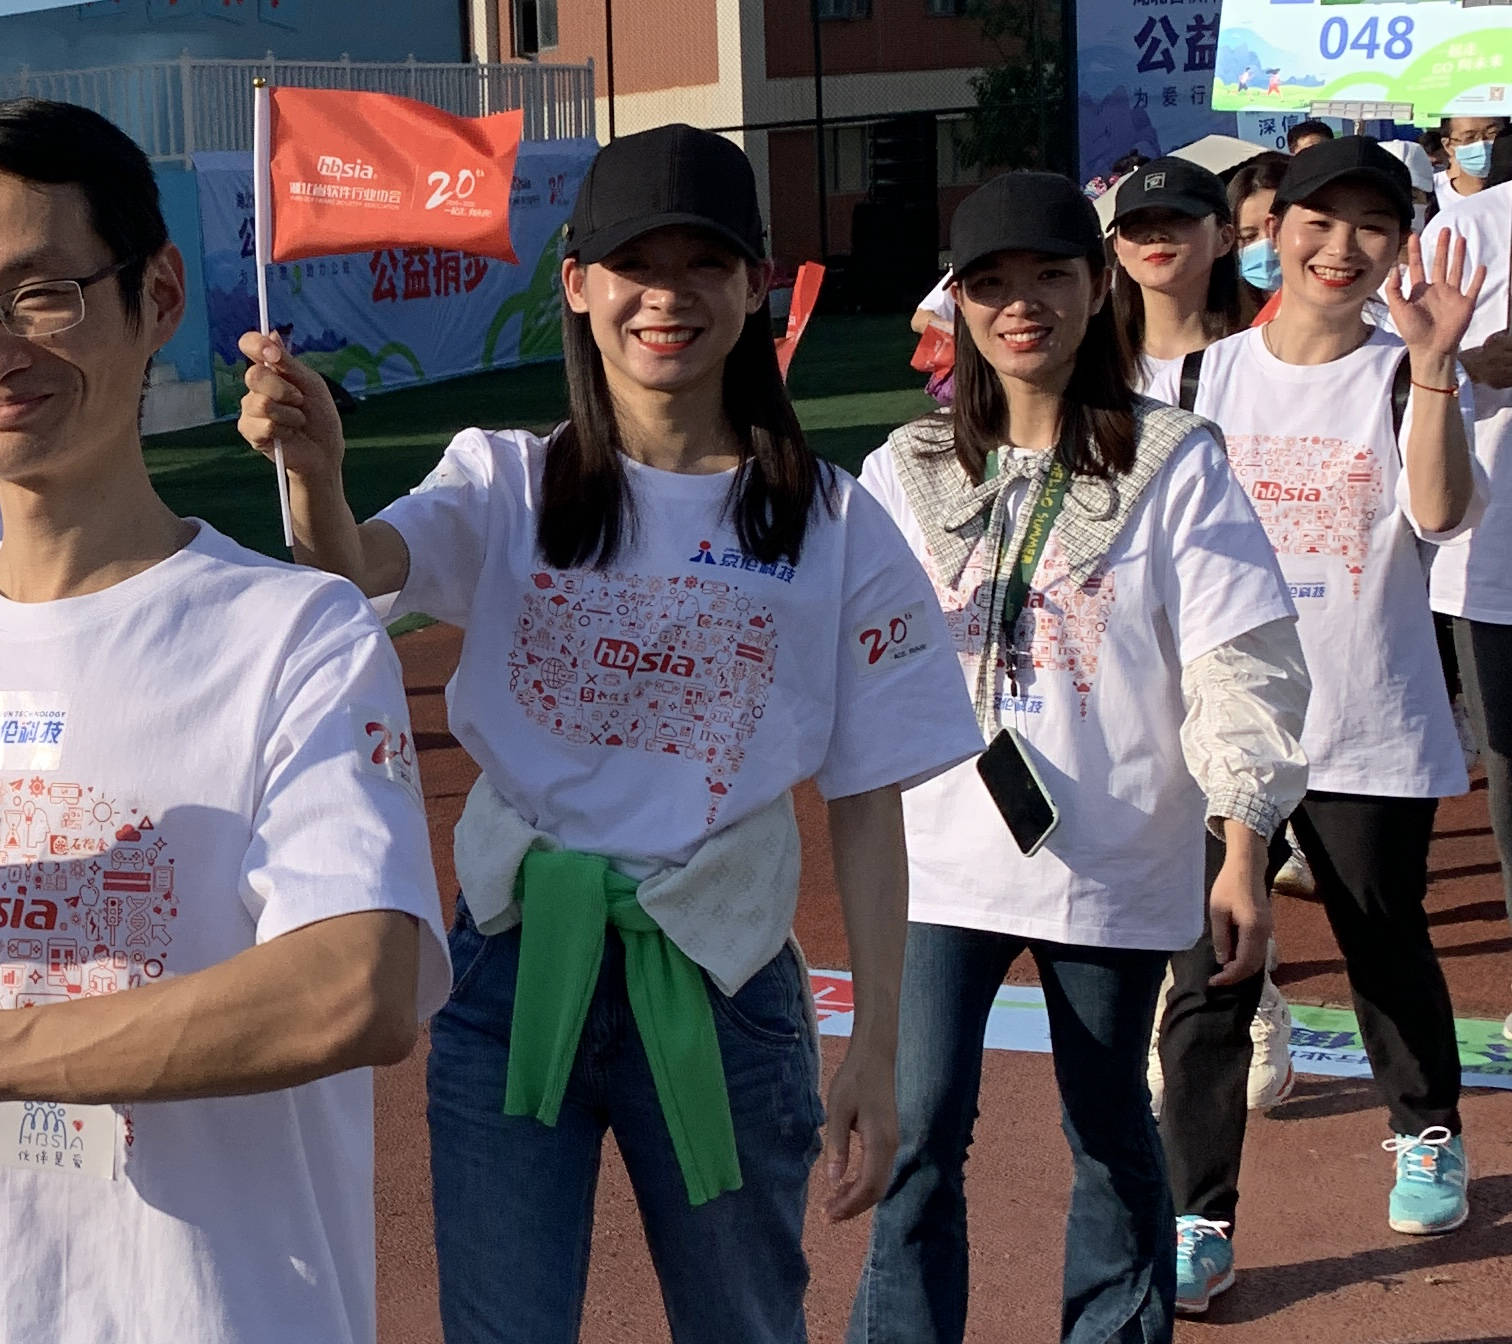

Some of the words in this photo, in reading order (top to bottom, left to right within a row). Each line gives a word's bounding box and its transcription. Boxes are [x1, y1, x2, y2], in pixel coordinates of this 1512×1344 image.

[1319, 15, 1415, 60] 048
[317, 155, 374, 181] hbsia
[1252, 480, 1322, 504] hbsia
[594, 637, 696, 679] hbsia
